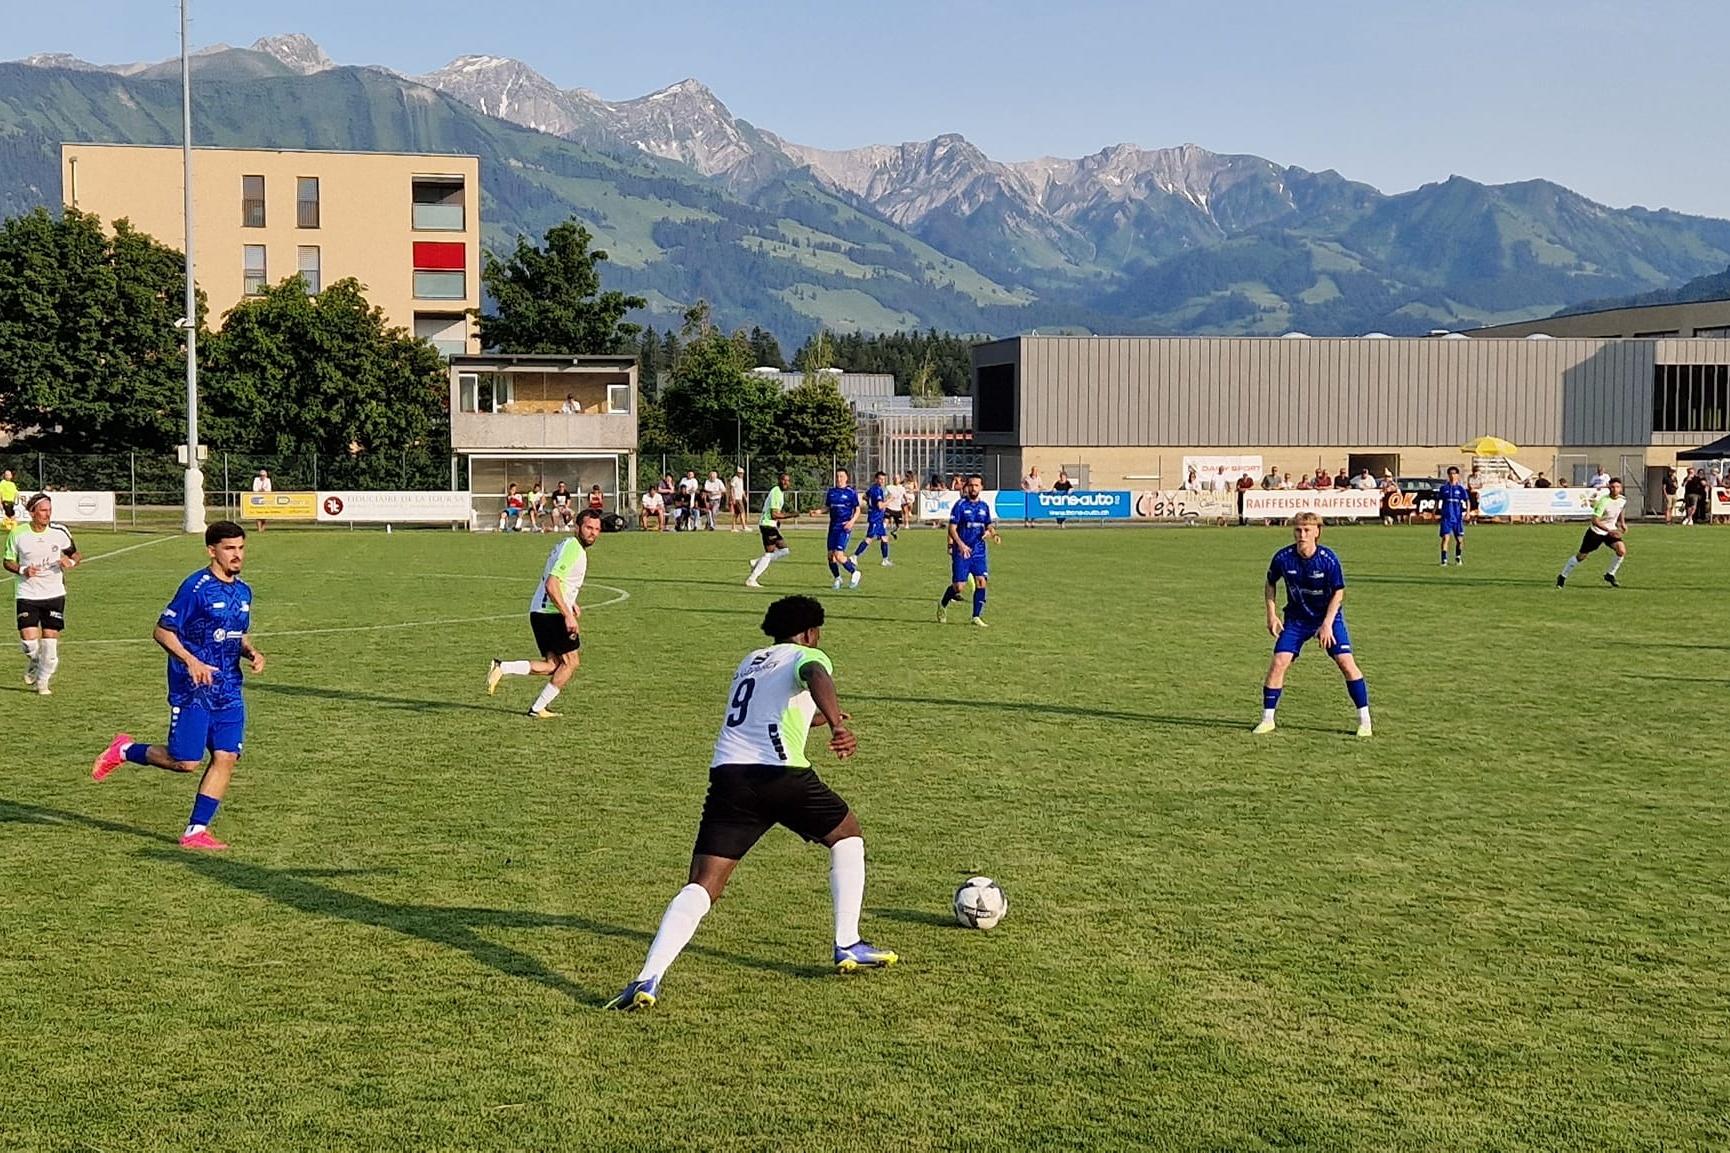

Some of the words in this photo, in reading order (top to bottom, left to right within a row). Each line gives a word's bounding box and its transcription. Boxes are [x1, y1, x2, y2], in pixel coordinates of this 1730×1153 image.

[1246, 499, 1310, 509] RAIFFEISEN
[1313, 499, 1377, 508] RAIFFEISEN
[1388, 492, 1418, 509] OK
[726, 677, 756, 728] 9
